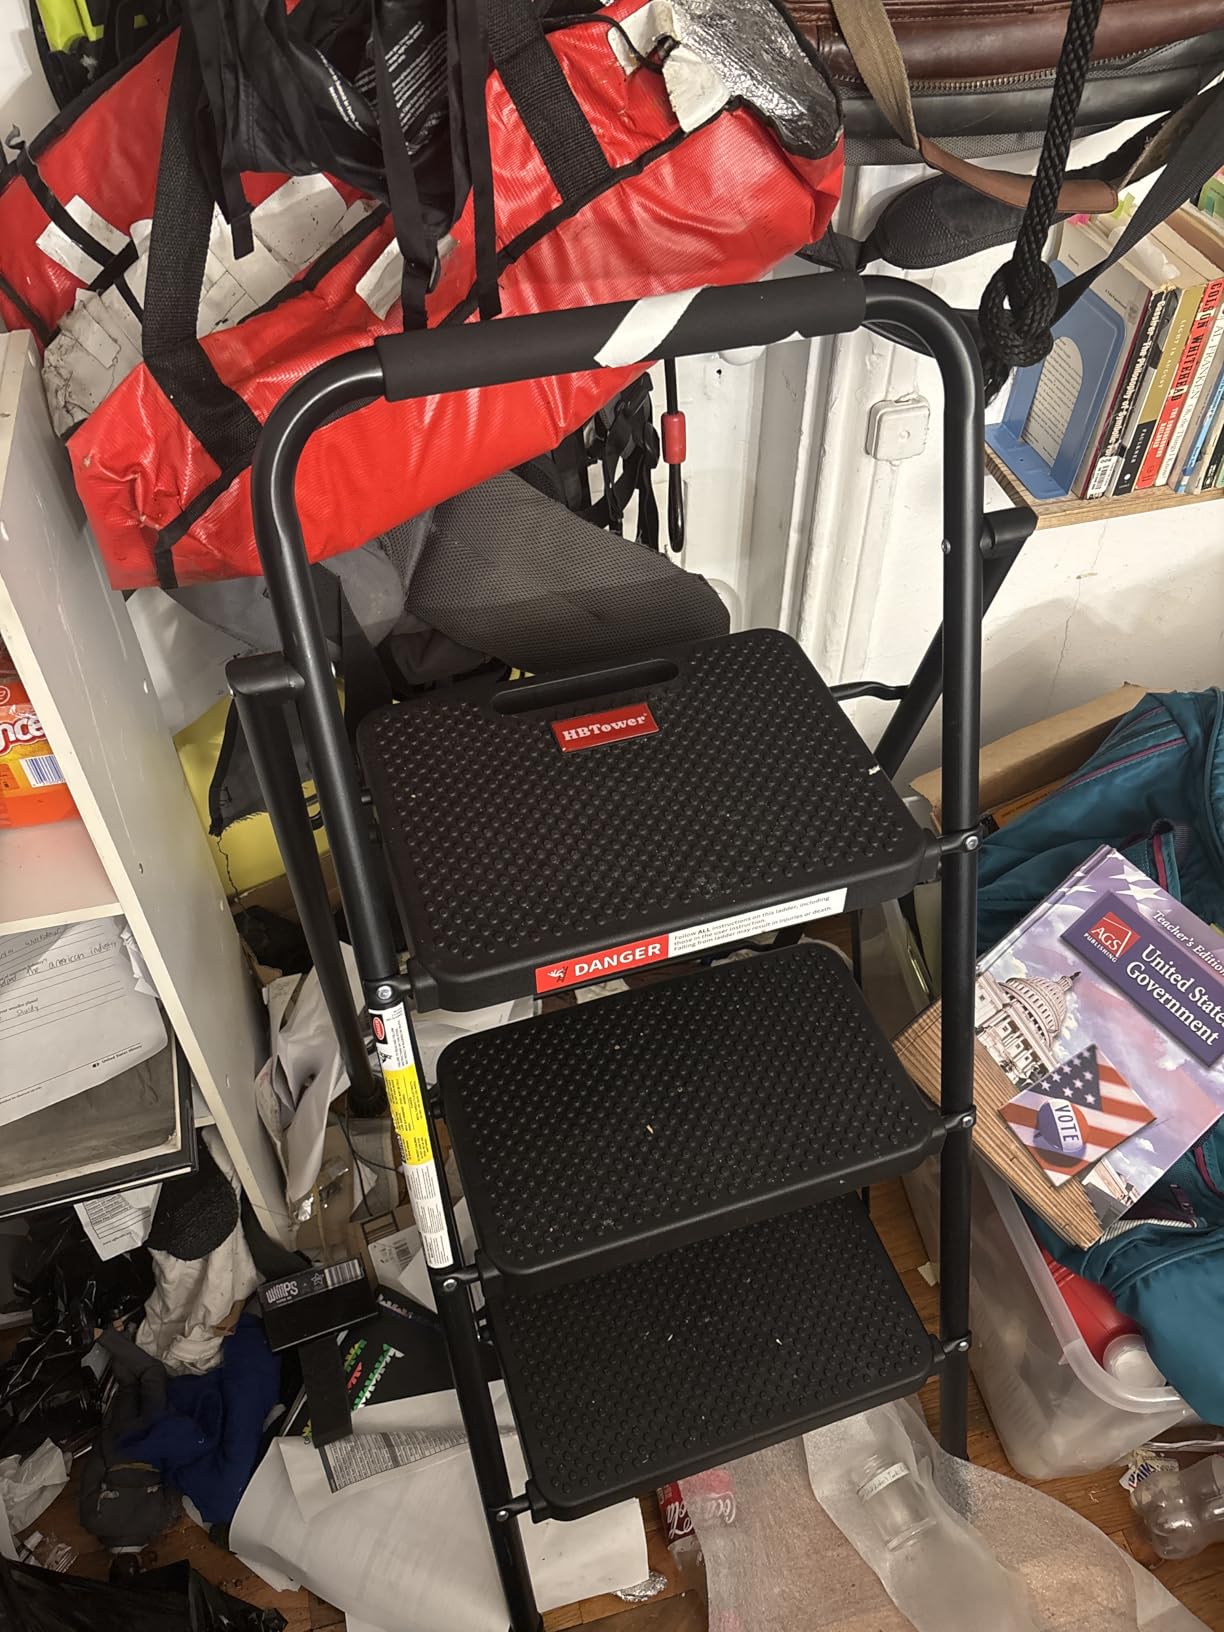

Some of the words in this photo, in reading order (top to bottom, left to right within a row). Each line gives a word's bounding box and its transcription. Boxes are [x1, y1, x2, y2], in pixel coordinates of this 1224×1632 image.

[1197, 282, 1222, 329] COLSON
[1174, 320, 1187, 344] LIGHT
[1122, 357, 1146, 400] Philosophy
[1157, 360, 1172, 388] AUGUST
[1170, 334, 1204, 401] WHITEHEAD
[1190, 345, 1217, 399] FRANKEN
[1108, 411, 1128, 444] Symbolic
[1170, 406, 1179, 419] THE
[1130, 429, 1147, 463] FAULKNER
[1169, 430, 1184, 454] Things
[562, 715, 646, 741] HBTower
[674, 931, 697, 941] Follow
[697, 927, 711, 935] ALL
[711, 915, 751, 932] instructions
[762, 908, 775, 918] this
[775, 904, 799, 915] ladder,
[799, 895, 831, 910] including
[674, 941, 697, 951] Falling
[697, 937, 713, 945] from
[714, 932, 736, 941] ladder
[736, 928, 751, 937] may
[751, 922, 771, 932] result
[778, 912, 803, 926] injuries
[812, 905, 833, 915] death.
[674, 938, 693, 946] those
[713, 928, 728, 936] user
[1083, 932, 1118, 963] PUBLISHING
[1091, 927, 1122, 951] AGS
[574, 943, 661, 977] DANGER
[1142, 944, 1195, 993] United
[1188, 986, 1224, 1028] State
[1126, 961, 1219, 1046] Government
[1055, 1105, 1079, 1141] VOTE
